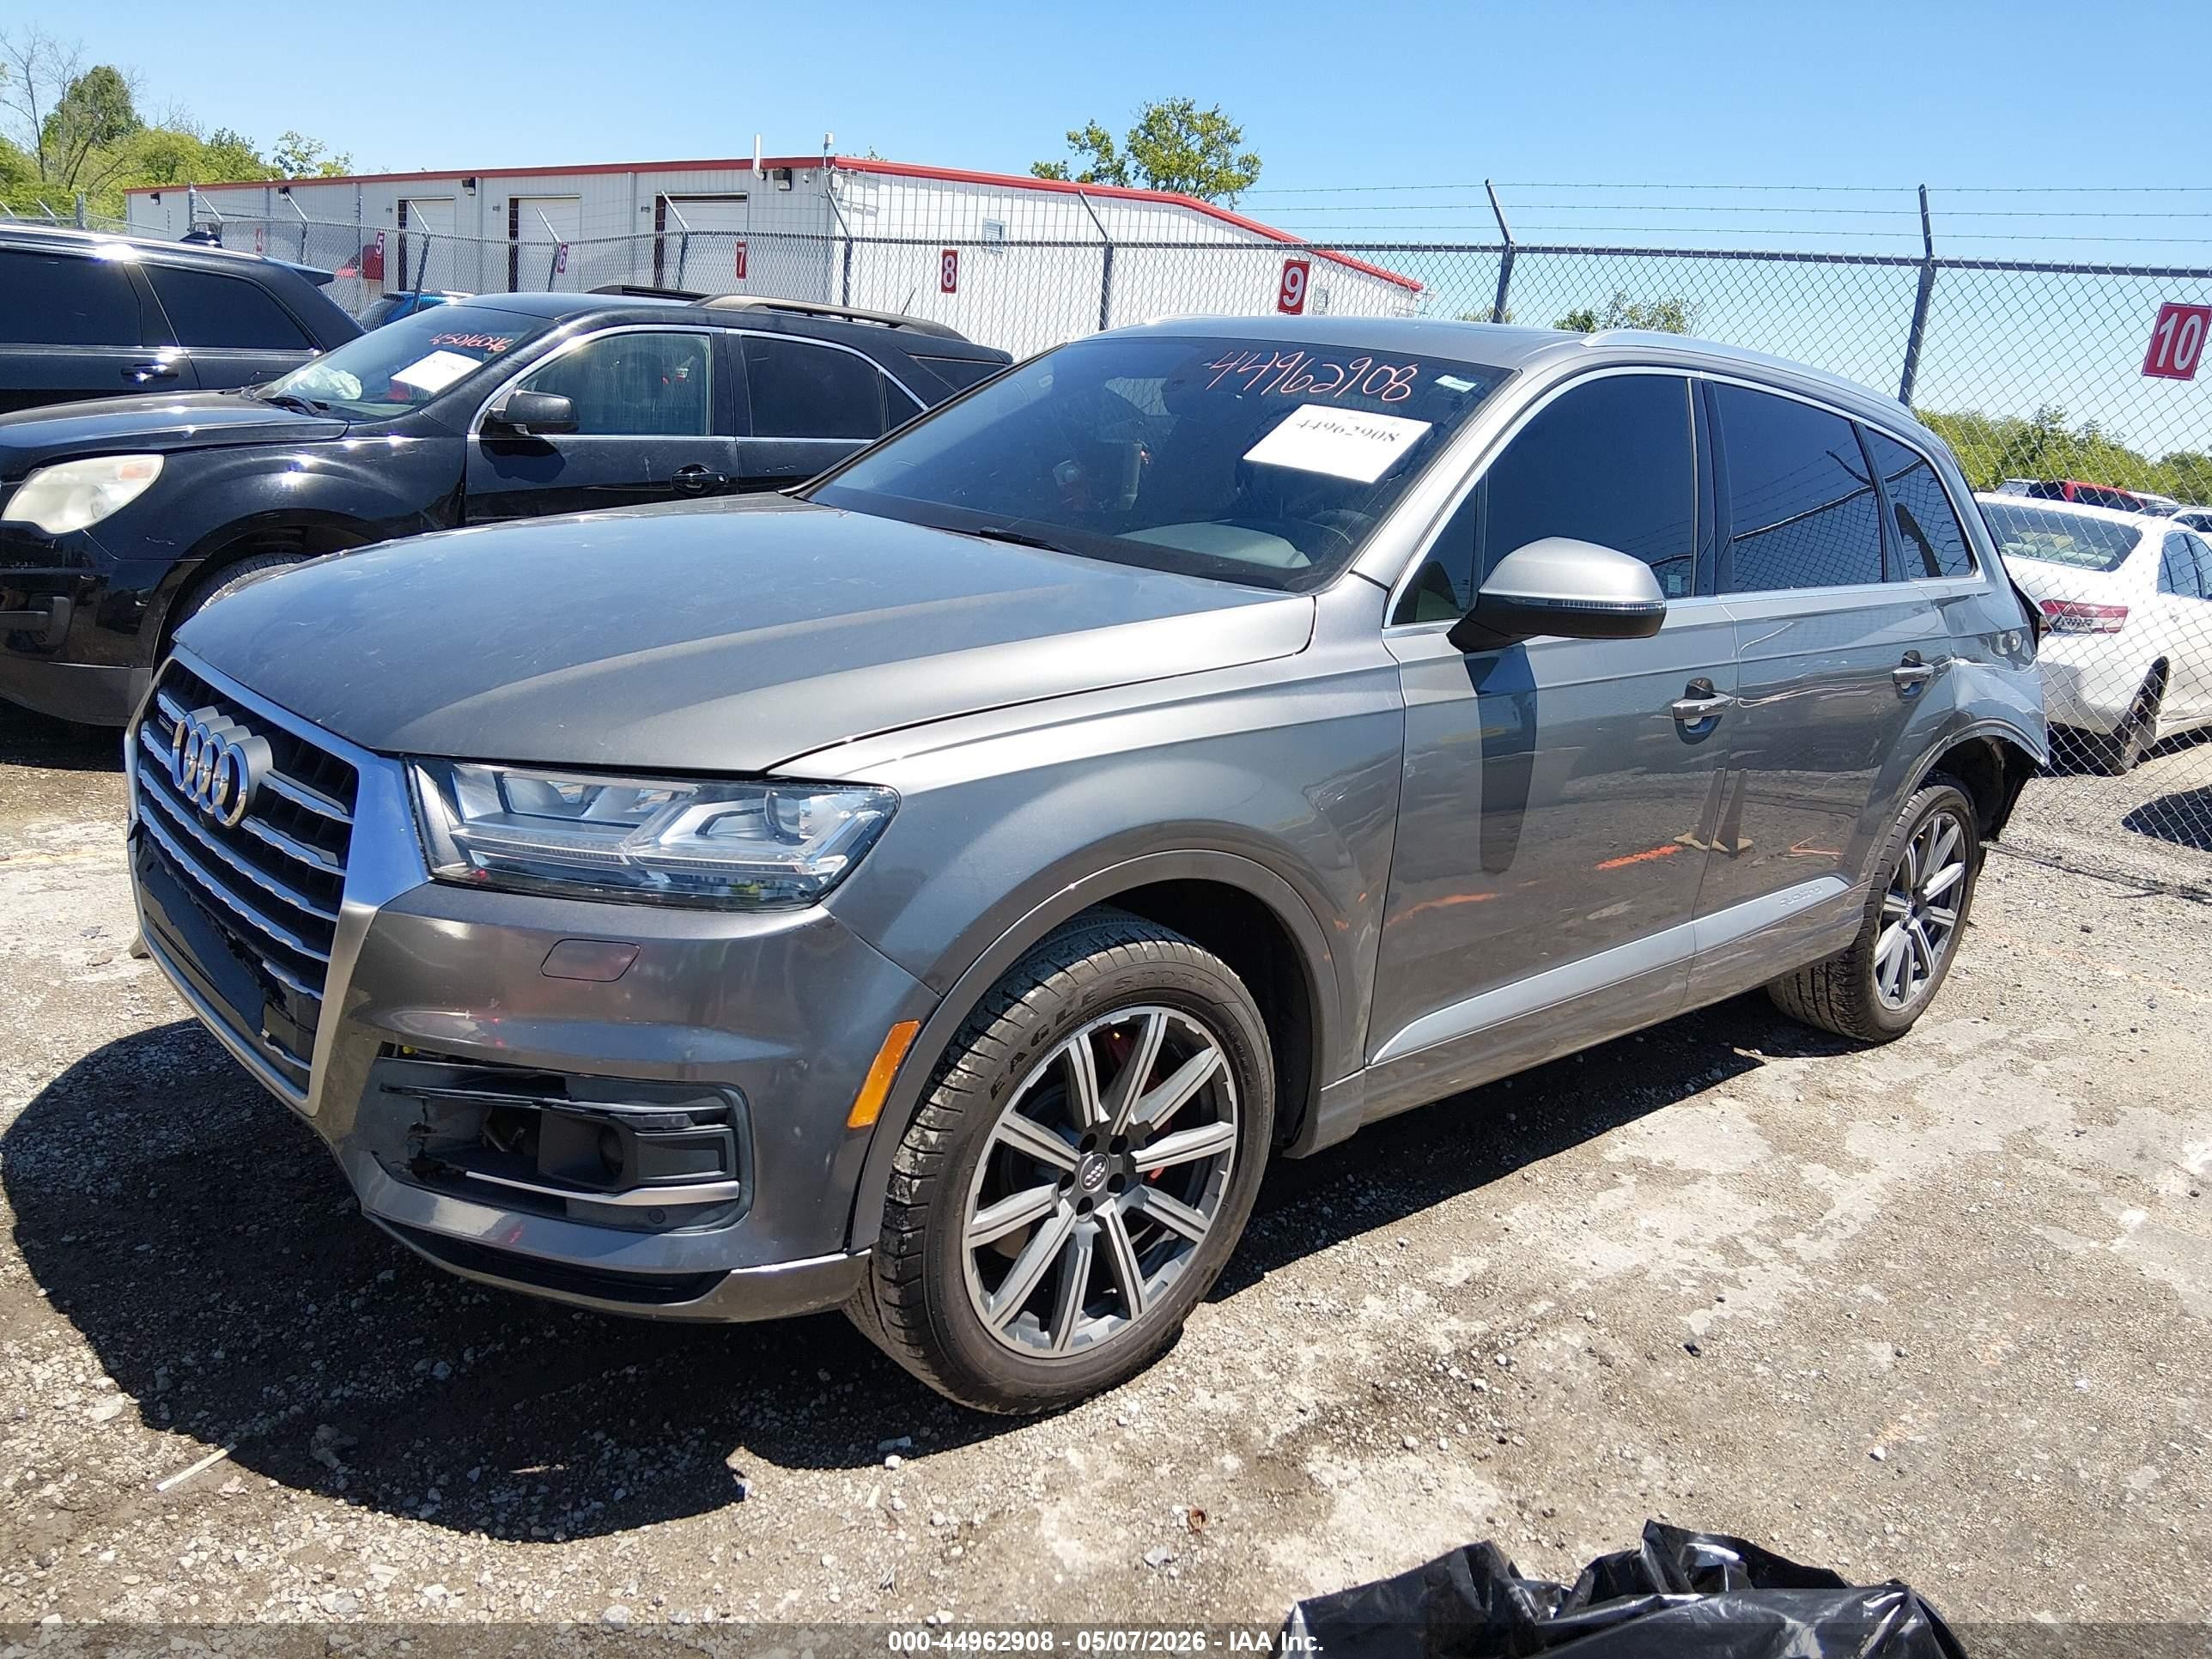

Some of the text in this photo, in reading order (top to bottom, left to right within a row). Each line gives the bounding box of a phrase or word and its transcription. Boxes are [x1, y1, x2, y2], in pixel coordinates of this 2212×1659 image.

[375, 235, 384, 255] 5
[559, 246, 568, 270] 6
[738, 246, 745, 274] 7
[943, 255, 956, 289] 8
[1283, 266, 1304, 307] 9
[2156, 313, 2203, 371] 10
[1204, 350, 1419, 402] 44962908
[990, 988, 1099, 1100] EAGLE
